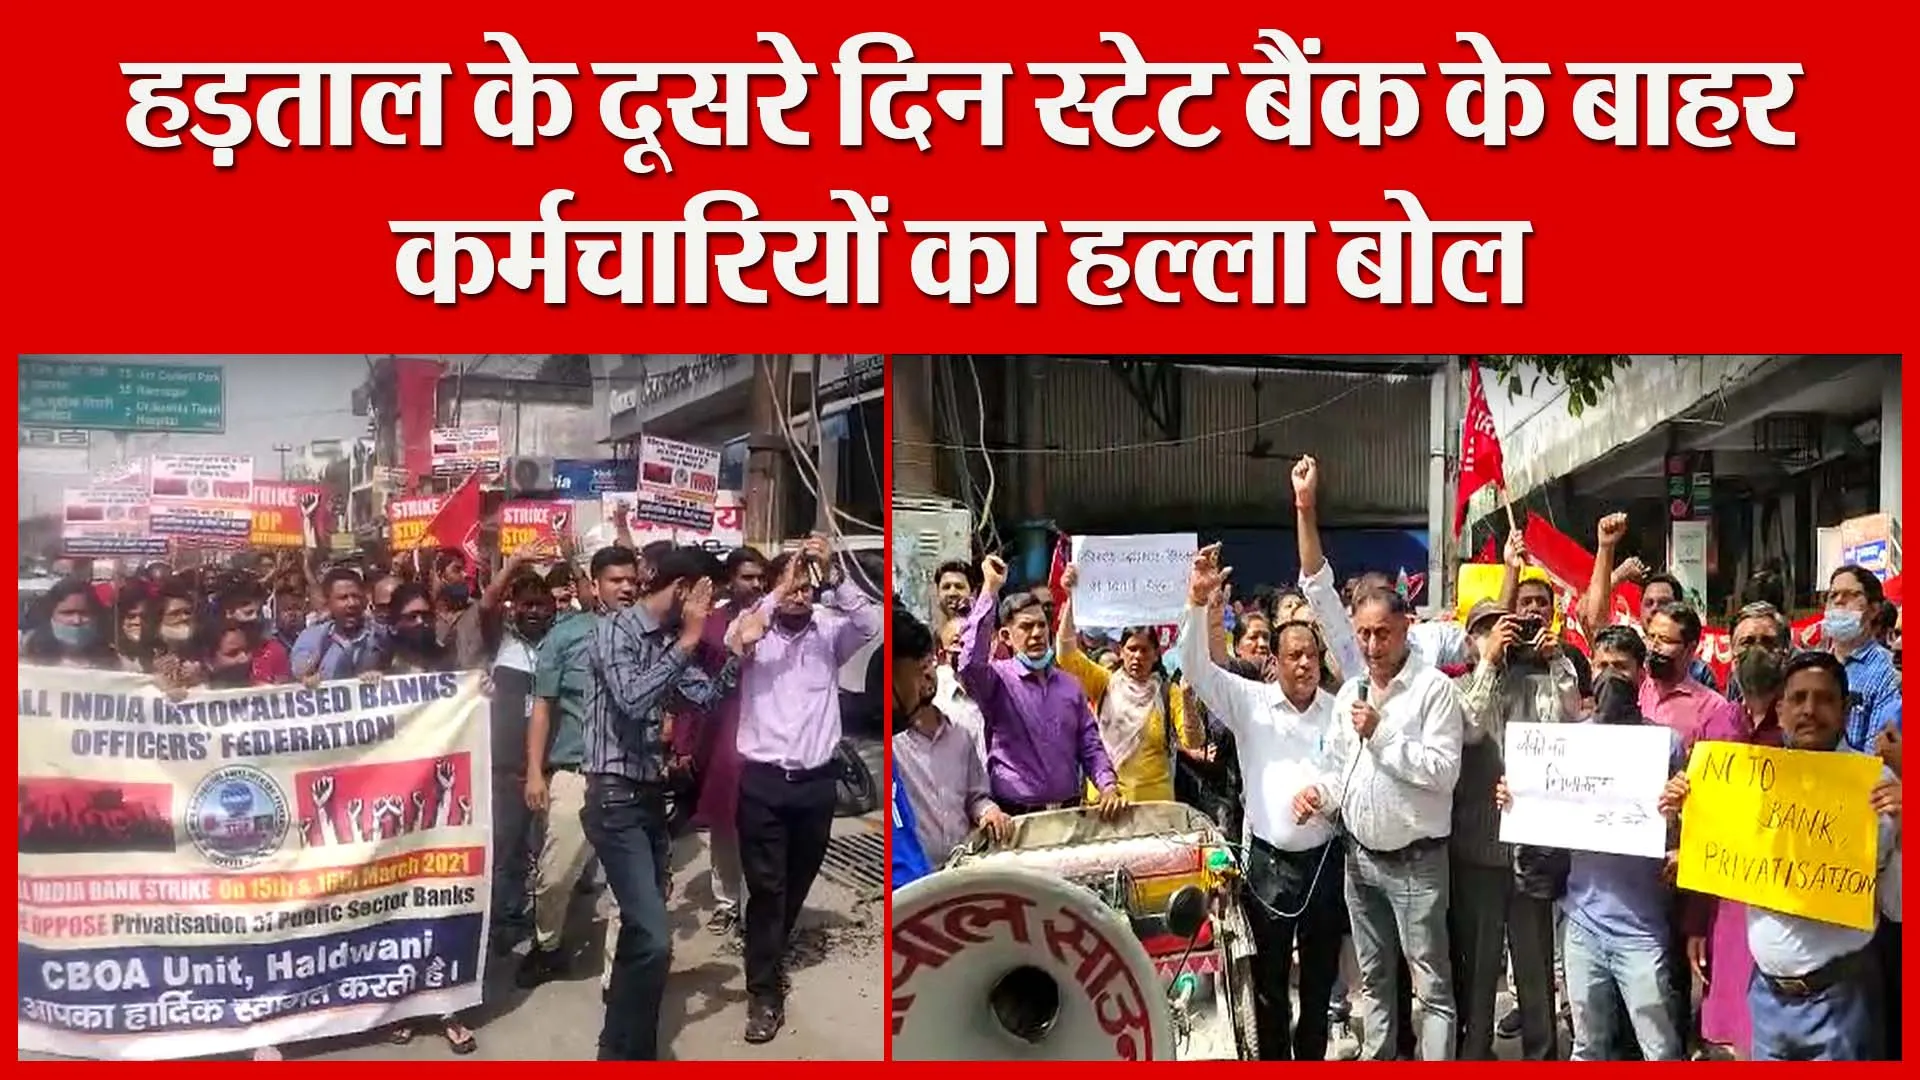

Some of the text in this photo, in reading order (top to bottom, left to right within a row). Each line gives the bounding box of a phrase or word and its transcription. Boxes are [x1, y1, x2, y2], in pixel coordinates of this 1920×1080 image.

[60, 691, 146, 724] INDIA
[359, 673, 458, 710] BANKS
[221, 714, 396, 759] FEDERATION
[422, 850, 470, 874] 2021
[1704, 840, 1877, 898] PRIVATISATION
[32, 913, 109, 937] OPPOSE
[112, 912, 247, 935] Privatisation
[414, 884, 475, 907] Banks
[42, 929, 433, 991] CBOA Unit, Haldwani
[23, 997, 117, 1030] आपका
[122, 990, 228, 1031] हार्दिक
[337, 963, 418, 1000] करती
